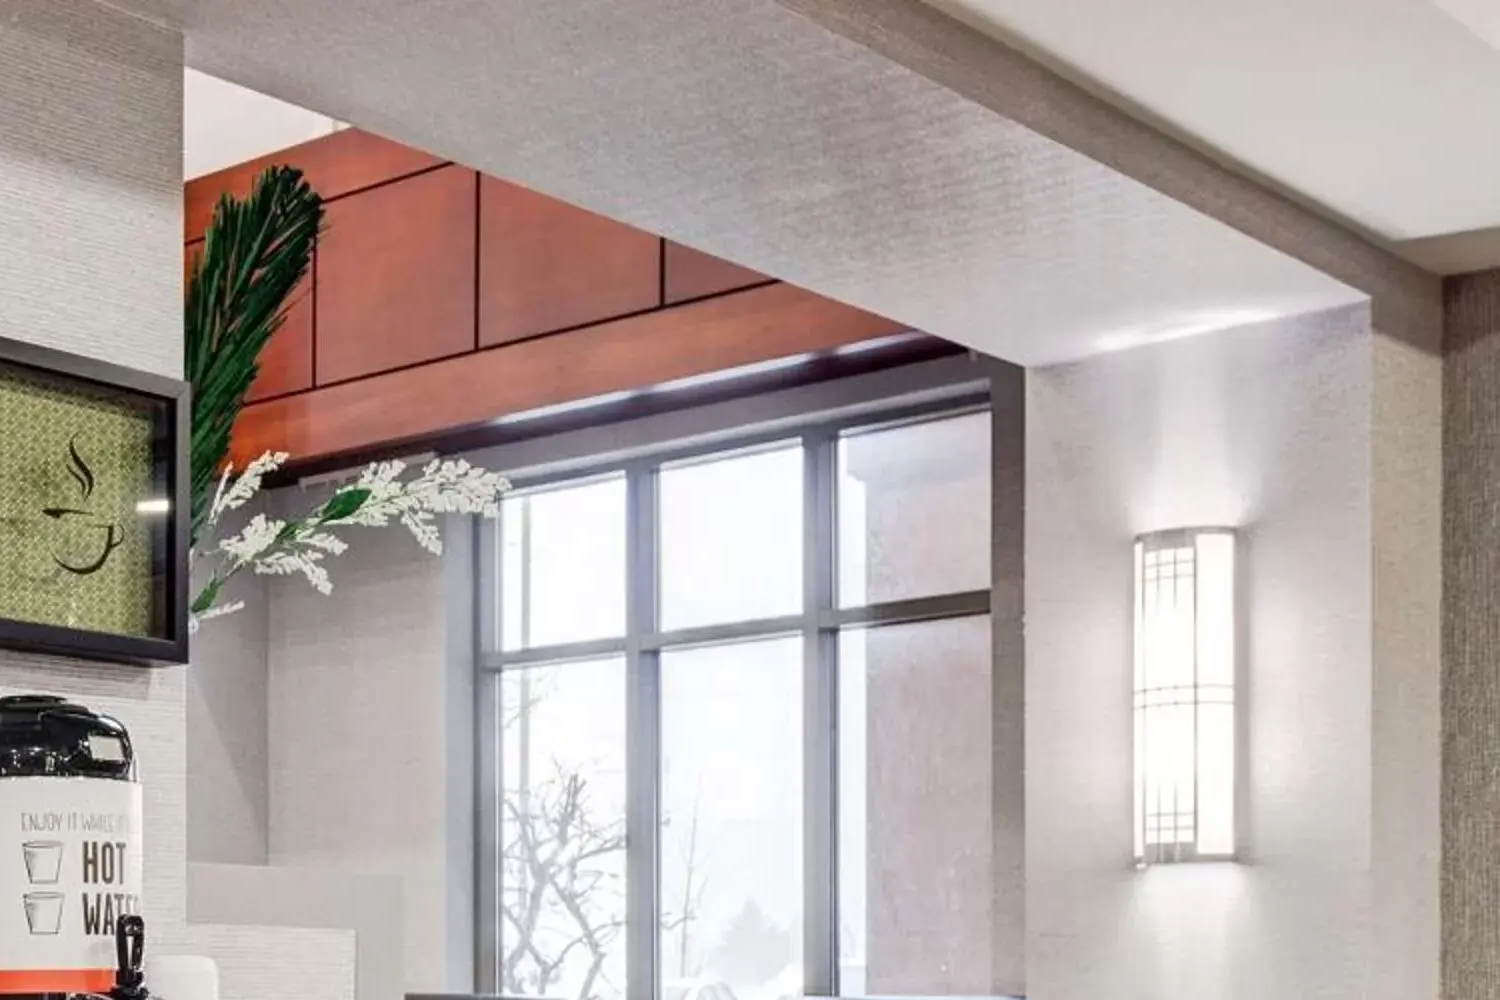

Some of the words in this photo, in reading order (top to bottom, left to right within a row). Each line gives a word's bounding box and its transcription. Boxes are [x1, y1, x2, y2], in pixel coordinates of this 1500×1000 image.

[21, 812, 63, 832] ENJOY
[67, 812, 78, 832] IT
[83, 840, 127, 885] HOT
